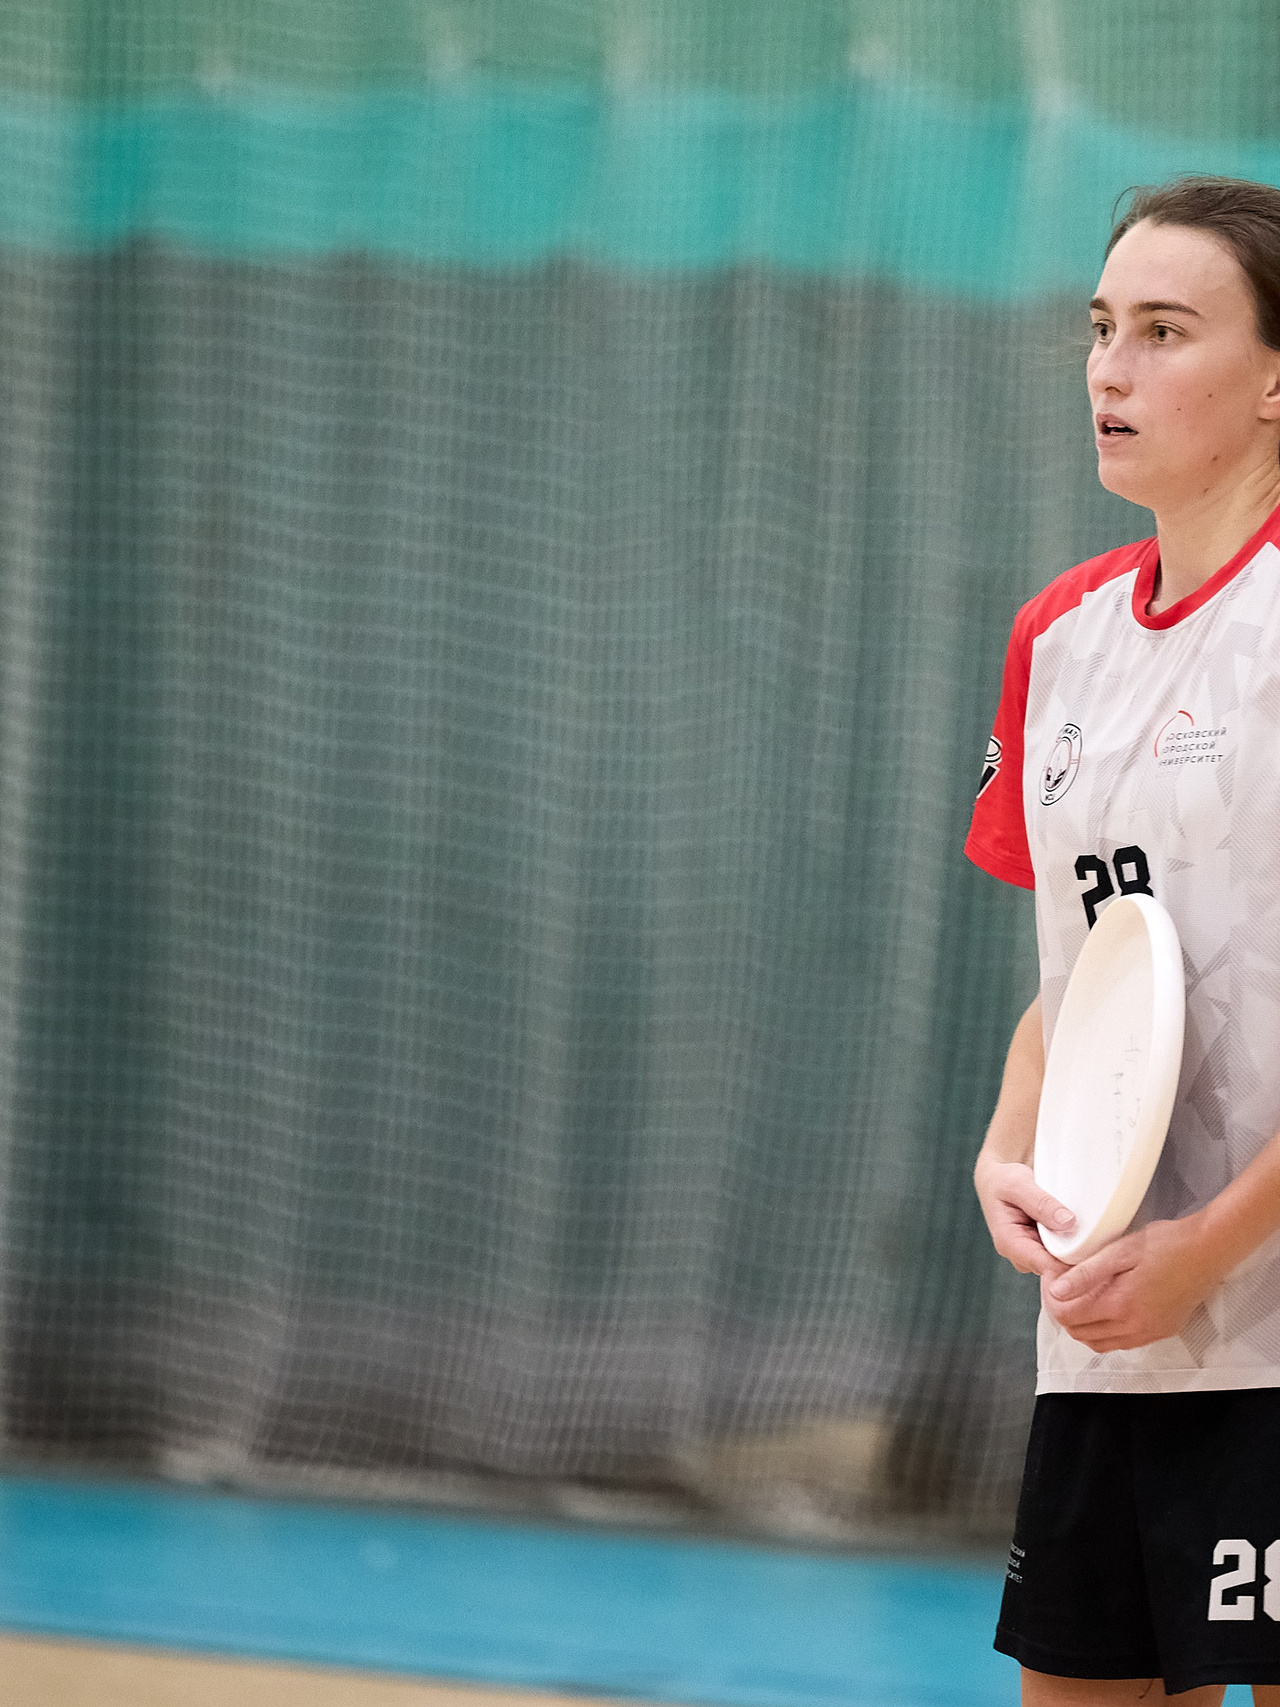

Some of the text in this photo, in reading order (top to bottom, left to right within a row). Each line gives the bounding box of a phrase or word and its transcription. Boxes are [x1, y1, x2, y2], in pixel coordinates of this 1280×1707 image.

[1166, 727, 1227, 741] ОСКОВСКИЙ
[1163, 741, 1216, 753] ОРОДСКОЙ
[1159, 755, 1223, 767] НИВЕРСИТЕТ
[1074, 845, 1154, 931] 28
